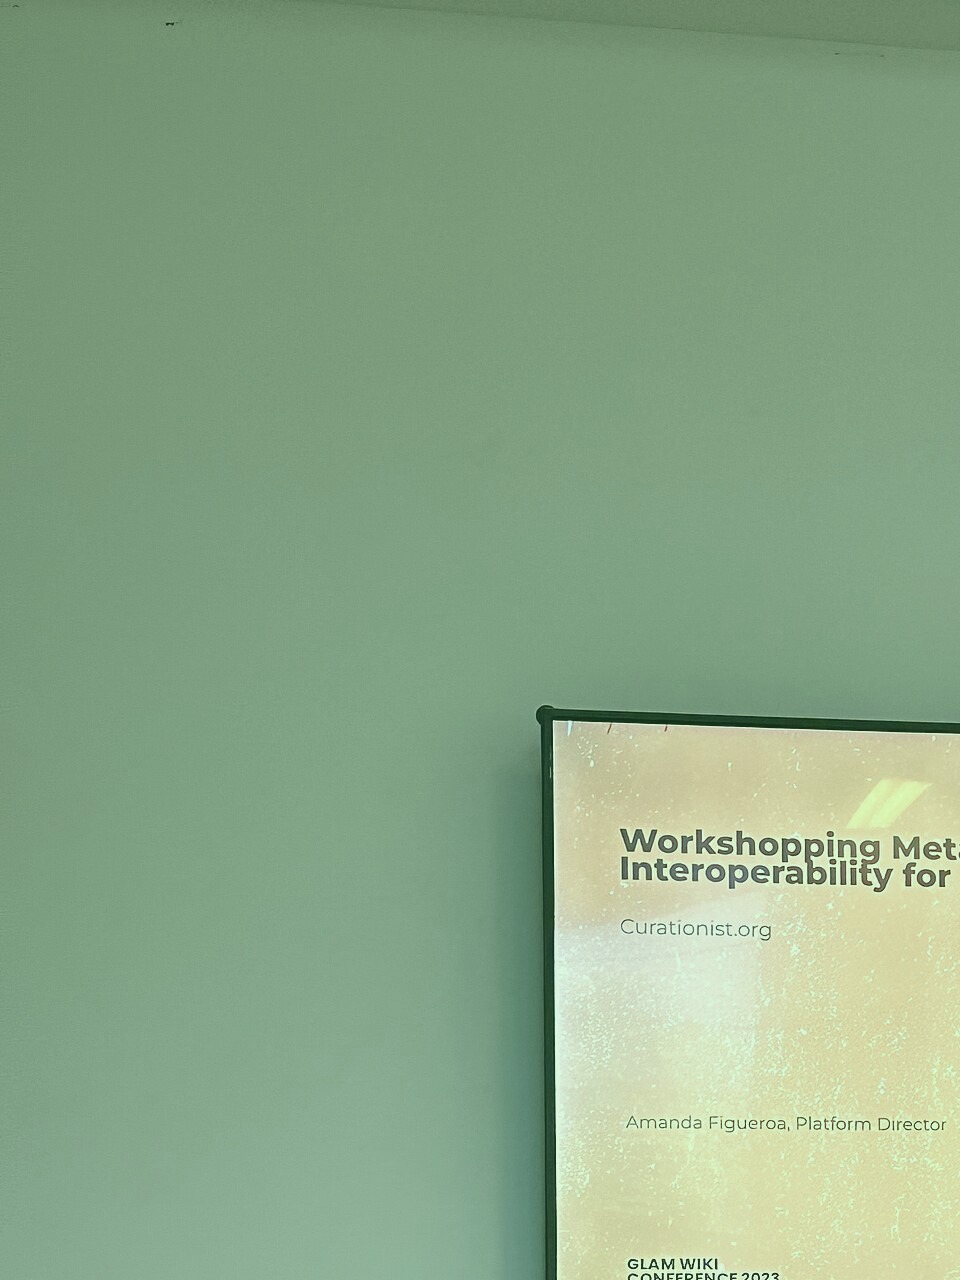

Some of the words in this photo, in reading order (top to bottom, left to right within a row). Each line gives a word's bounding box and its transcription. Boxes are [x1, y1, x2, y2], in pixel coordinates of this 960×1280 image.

[620, 828, 880, 863] Workshopping
[620, 856, 892, 892] Interoperability
[902, 862, 951, 888] for
[620, 918, 772, 940] Curationist.org
[626, 1115, 702, 1130] Amanda
[709, 1115, 790, 1133] Figueroa,
[796, 1116, 872, 1131] Platform
[877, 1116, 947, 1132] Director
[627, 1258, 675, 1270] GLAM
[679, 1258, 718, 1270] WIKI
